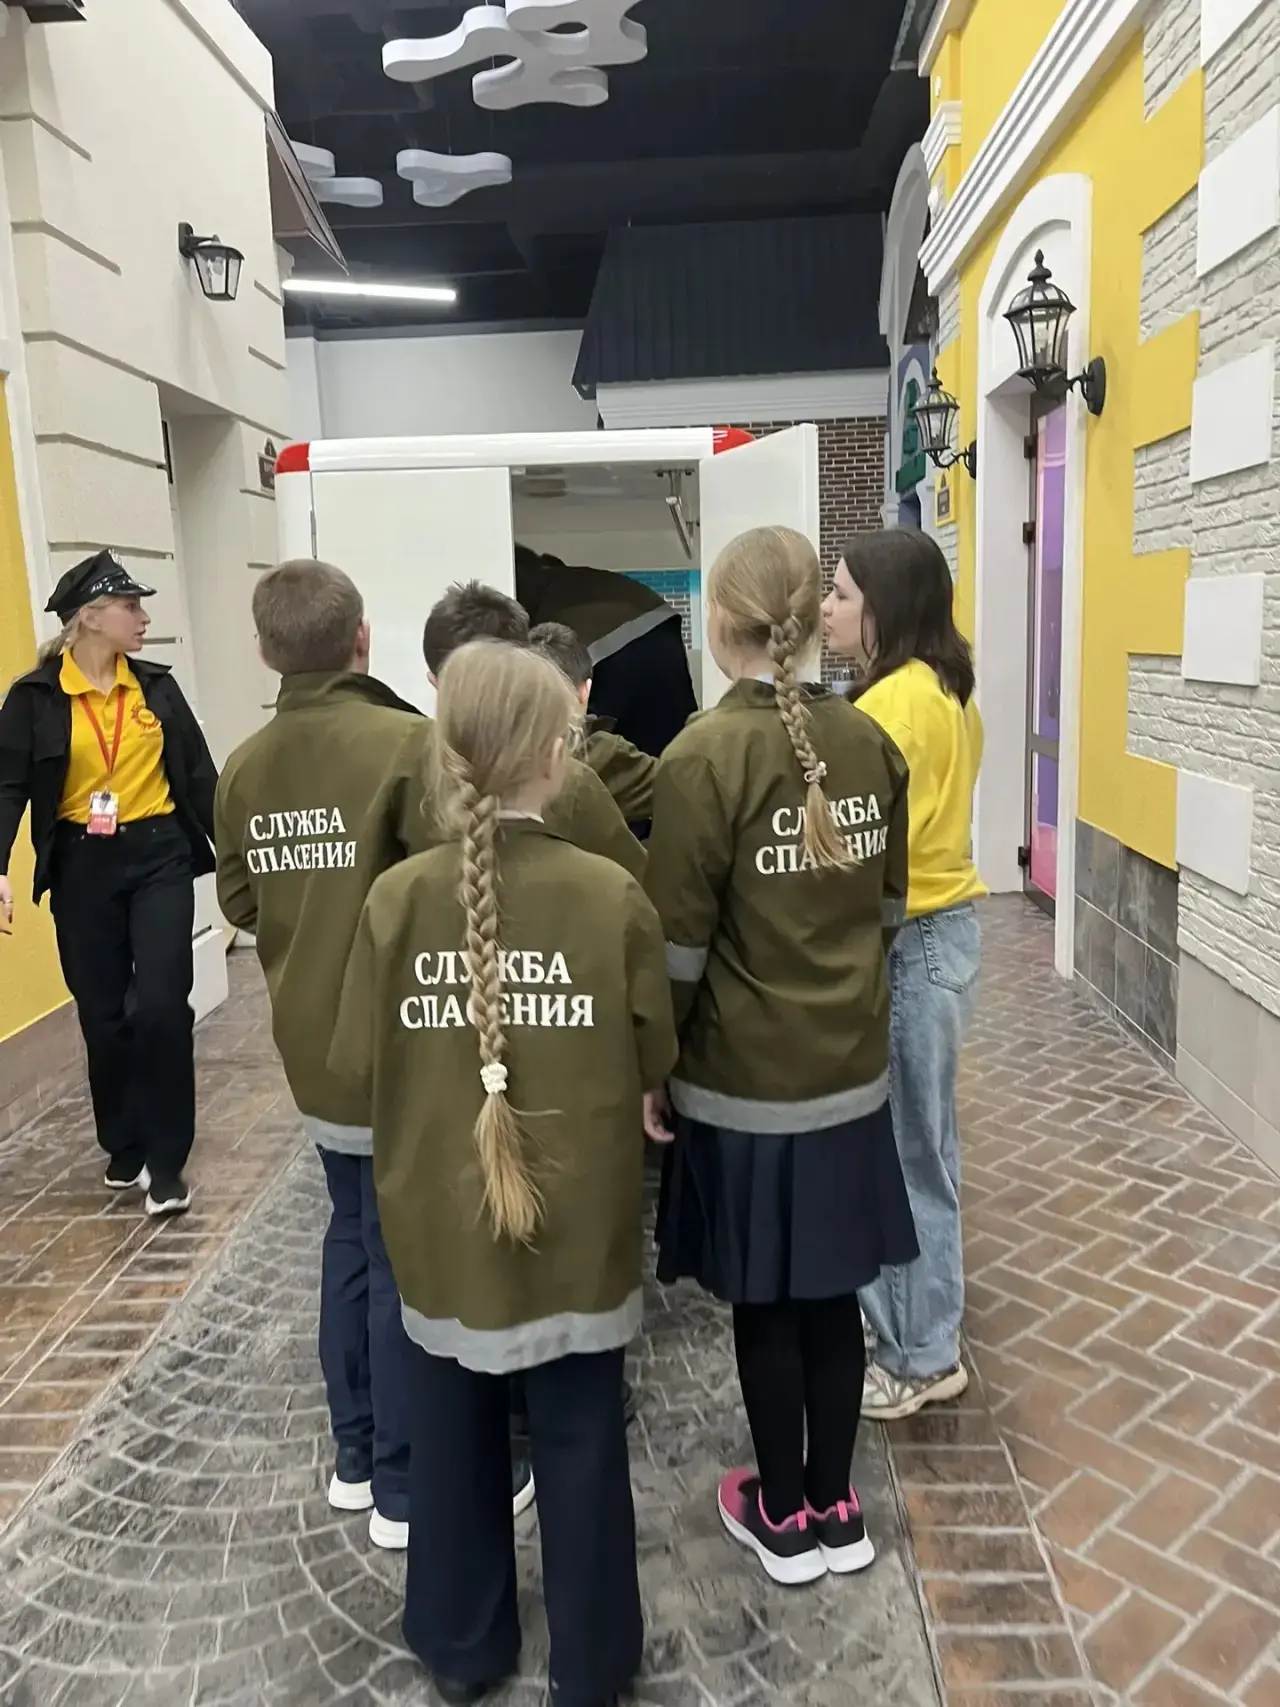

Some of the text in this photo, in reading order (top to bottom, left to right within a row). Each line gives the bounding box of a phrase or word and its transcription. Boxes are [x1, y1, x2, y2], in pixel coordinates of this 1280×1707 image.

[249, 806, 346, 841] СЛУЖБА
[771, 793, 882, 837] СЛЖБА
[246, 840, 357, 874] СПАСЕНИЯ
[755, 825, 889, 875] СПАНИЯ
